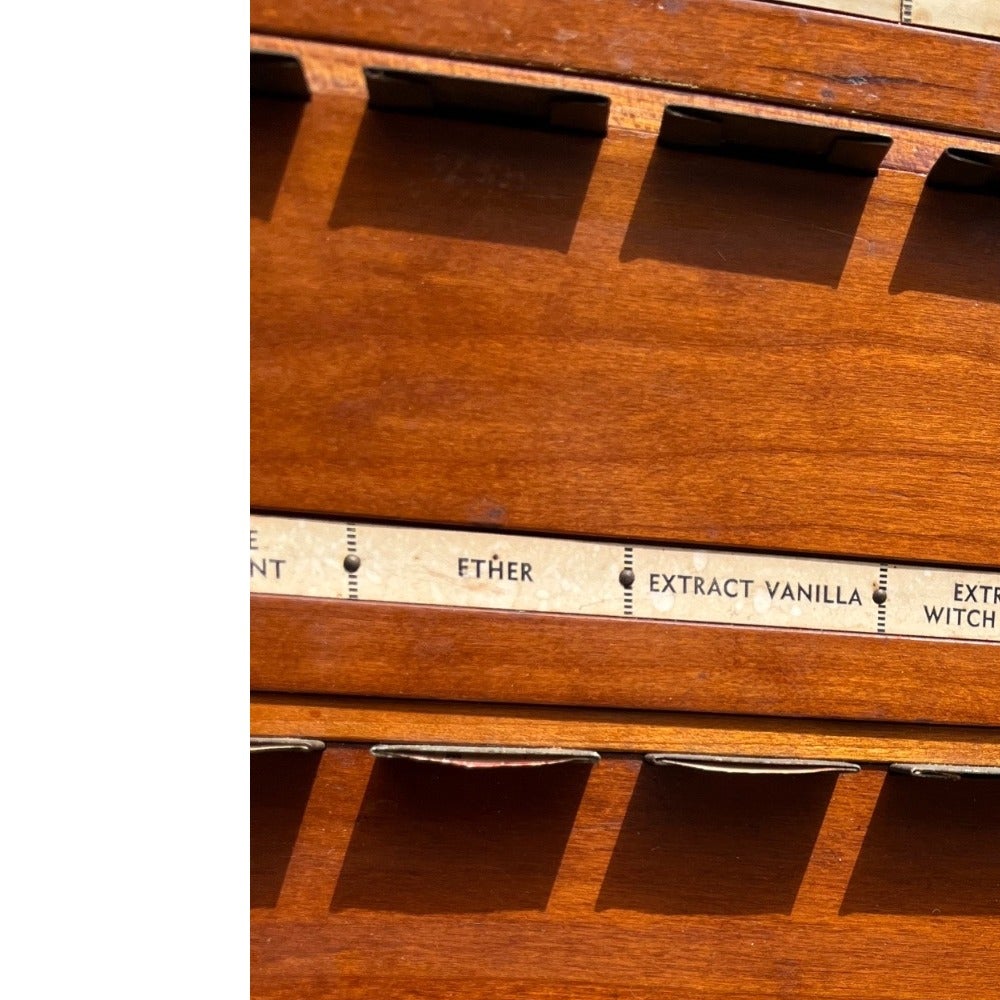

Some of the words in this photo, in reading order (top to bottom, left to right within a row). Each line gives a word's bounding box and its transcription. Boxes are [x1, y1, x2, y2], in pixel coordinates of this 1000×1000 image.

[458, 557, 533, 582] ETHER
[649, 573, 752, 598] EXTRACT
[765, 581, 863, 607] VANILLA
[923, 605, 996, 628] WITCH
